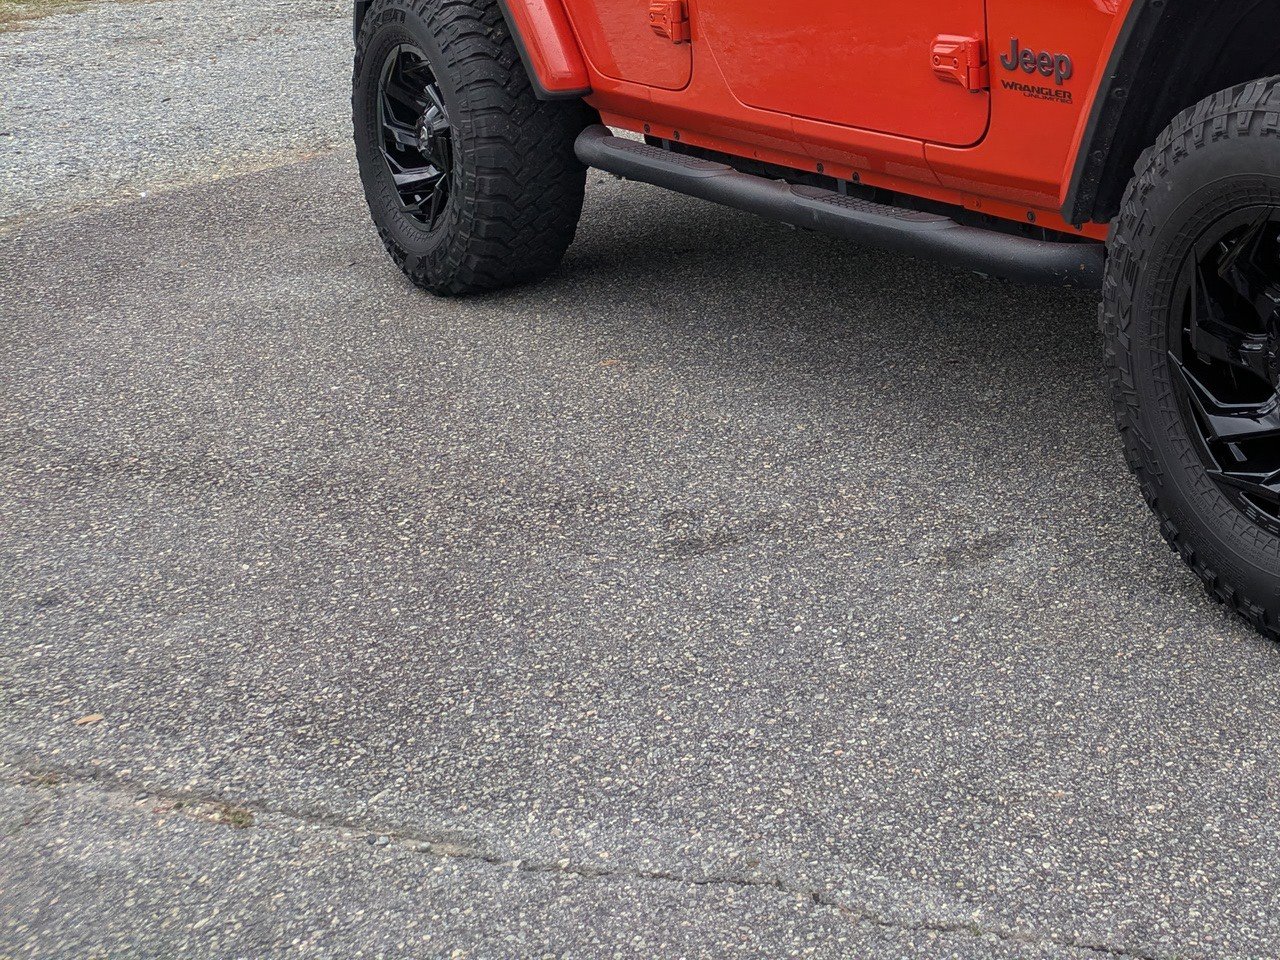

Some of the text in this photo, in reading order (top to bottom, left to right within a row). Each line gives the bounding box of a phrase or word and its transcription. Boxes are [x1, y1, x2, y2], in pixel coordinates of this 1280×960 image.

[1000, 36, 1072, 85] Jeep
[1001, 79, 1072, 100] WRANGLER
[1023, 92, 1073, 104] UNLIMITED
